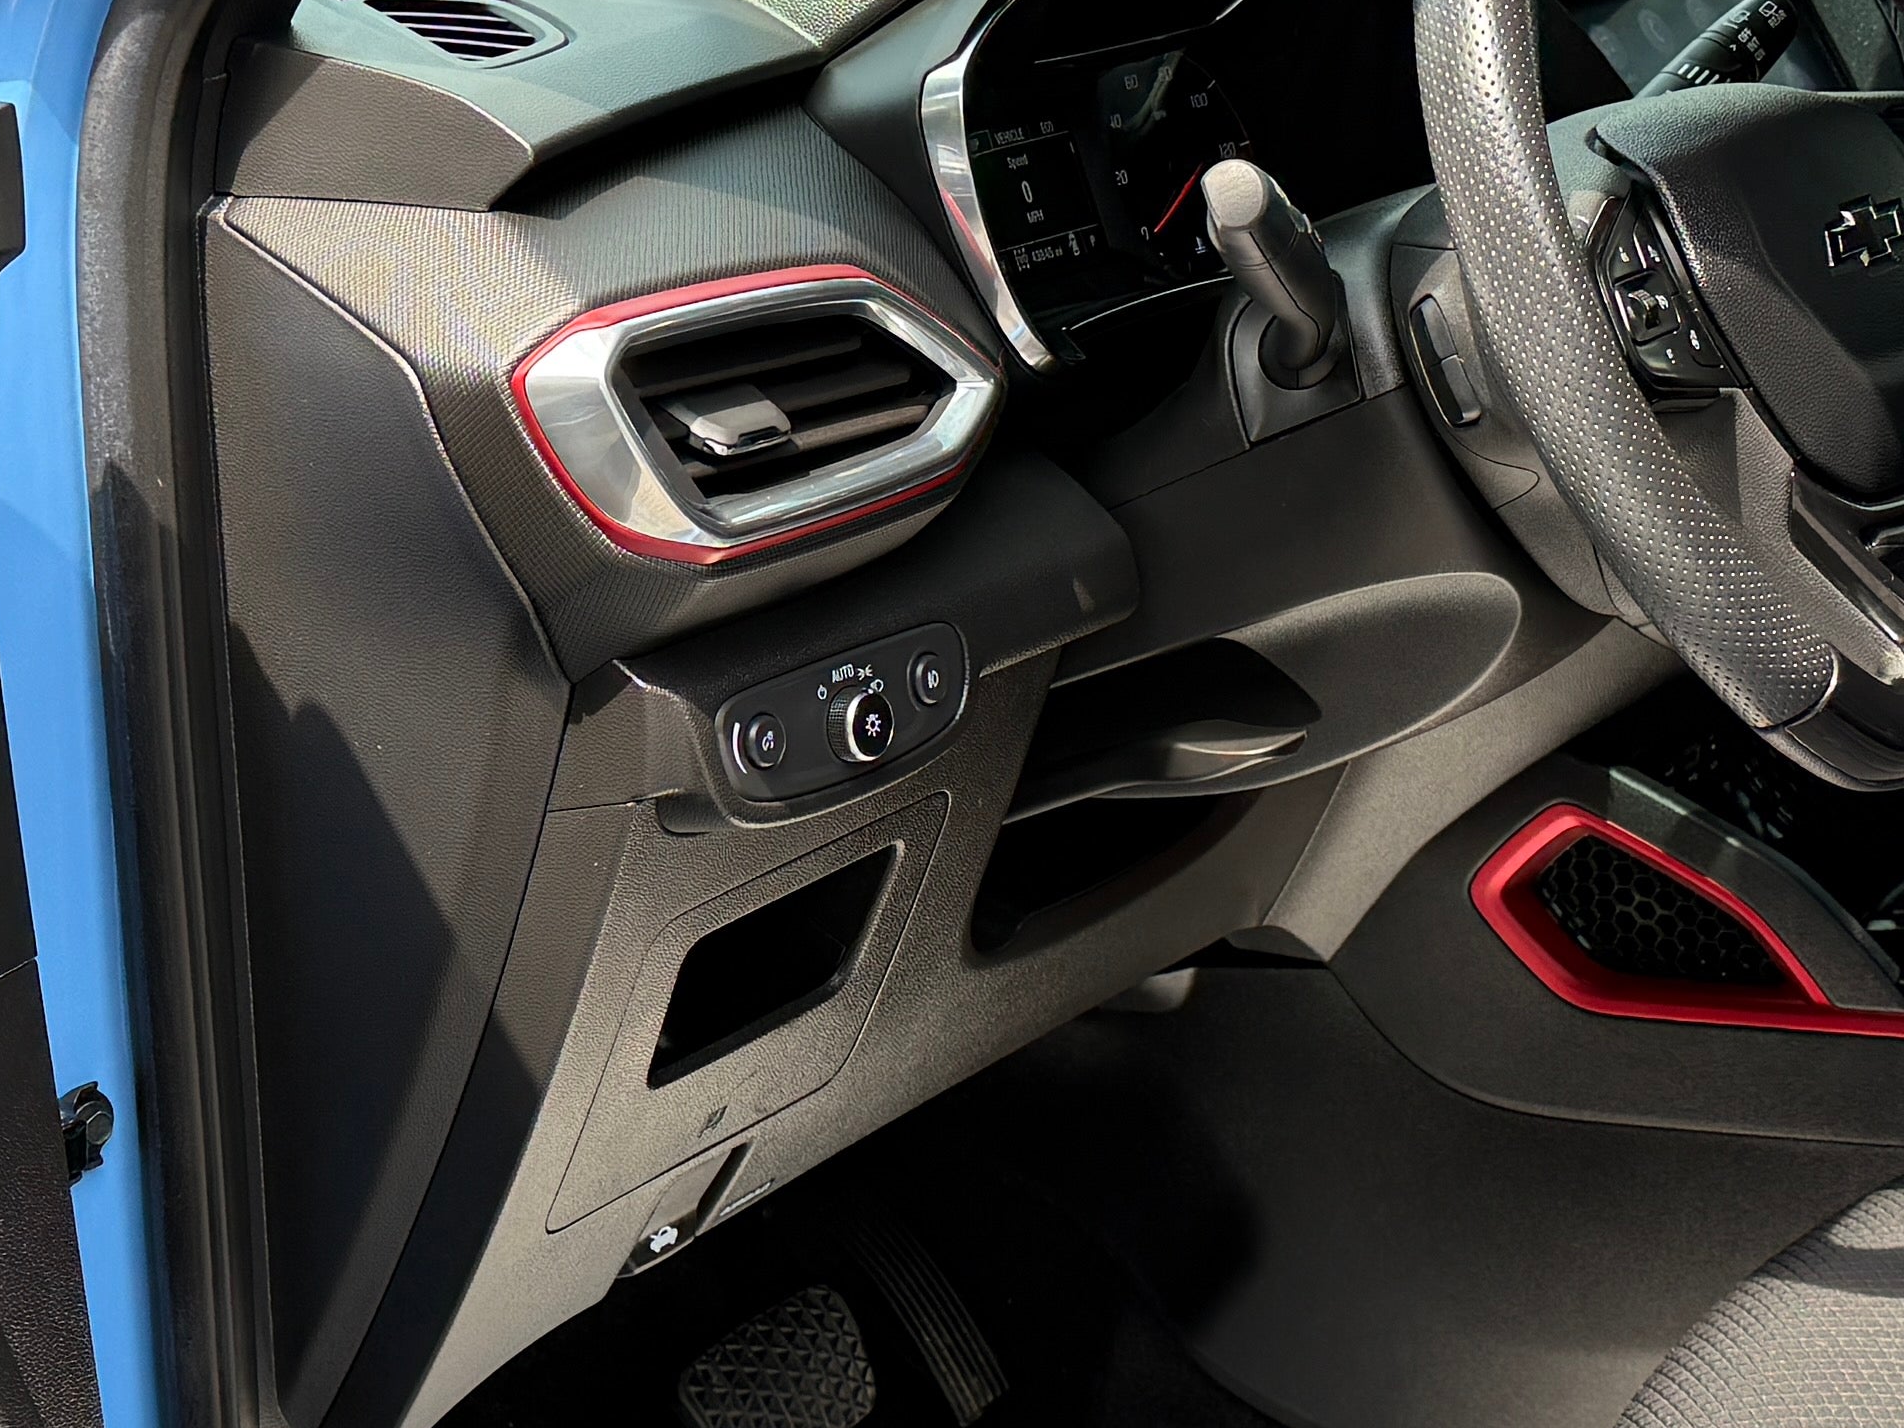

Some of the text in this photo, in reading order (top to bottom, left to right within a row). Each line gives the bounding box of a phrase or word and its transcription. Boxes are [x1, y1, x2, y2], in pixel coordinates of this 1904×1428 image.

[1190, 92, 1208, 108] 100
[993, 126, 1025, 145] VEHICLE
[1218, 142, 1236, 159] 120
[1007, 153, 1028, 170] Speed
[1021, 180, 1033, 204] 0
[1027, 209, 1044, 224] MPH
[831, 664, 855, 683] AUTO
